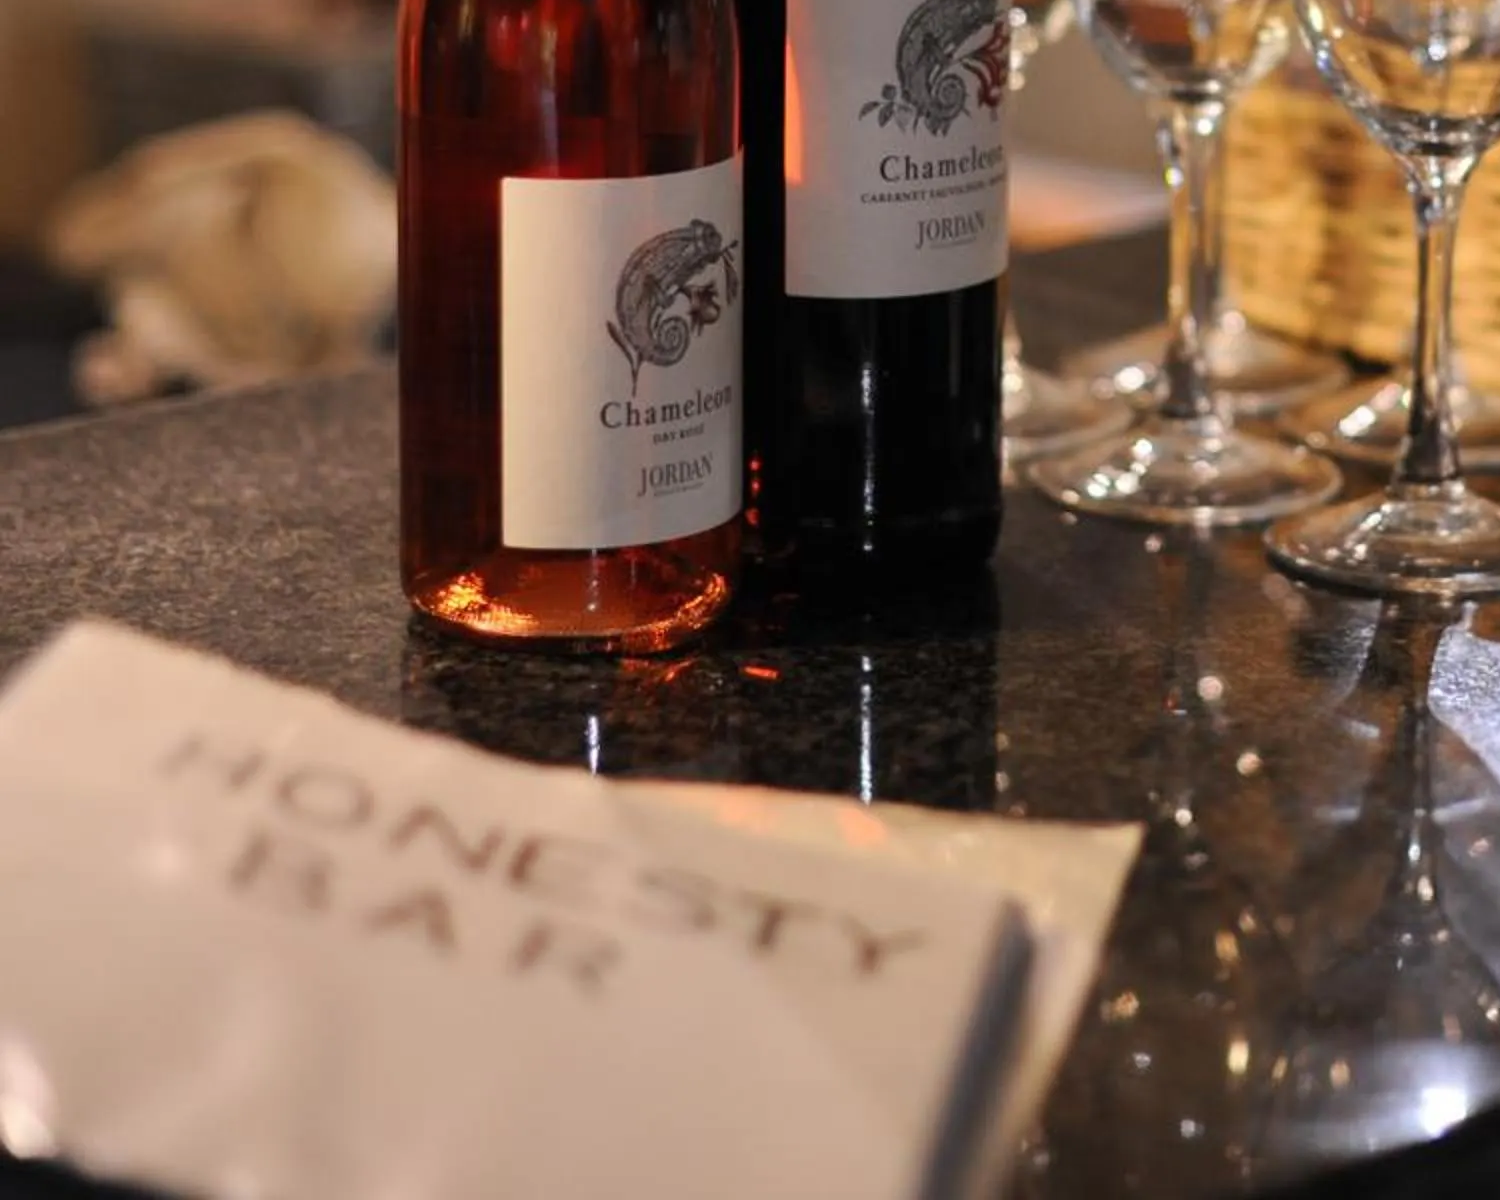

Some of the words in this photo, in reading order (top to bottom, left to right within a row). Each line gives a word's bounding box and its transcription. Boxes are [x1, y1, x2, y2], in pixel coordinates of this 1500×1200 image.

[915, 210, 985, 250] JORDAN
[600, 385, 732, 429] Chameleon
[637, 452, 713, 497] JORDAN
[158, 732, 928, 976] HONESTY
[225, 828, 626, 993] BAR
